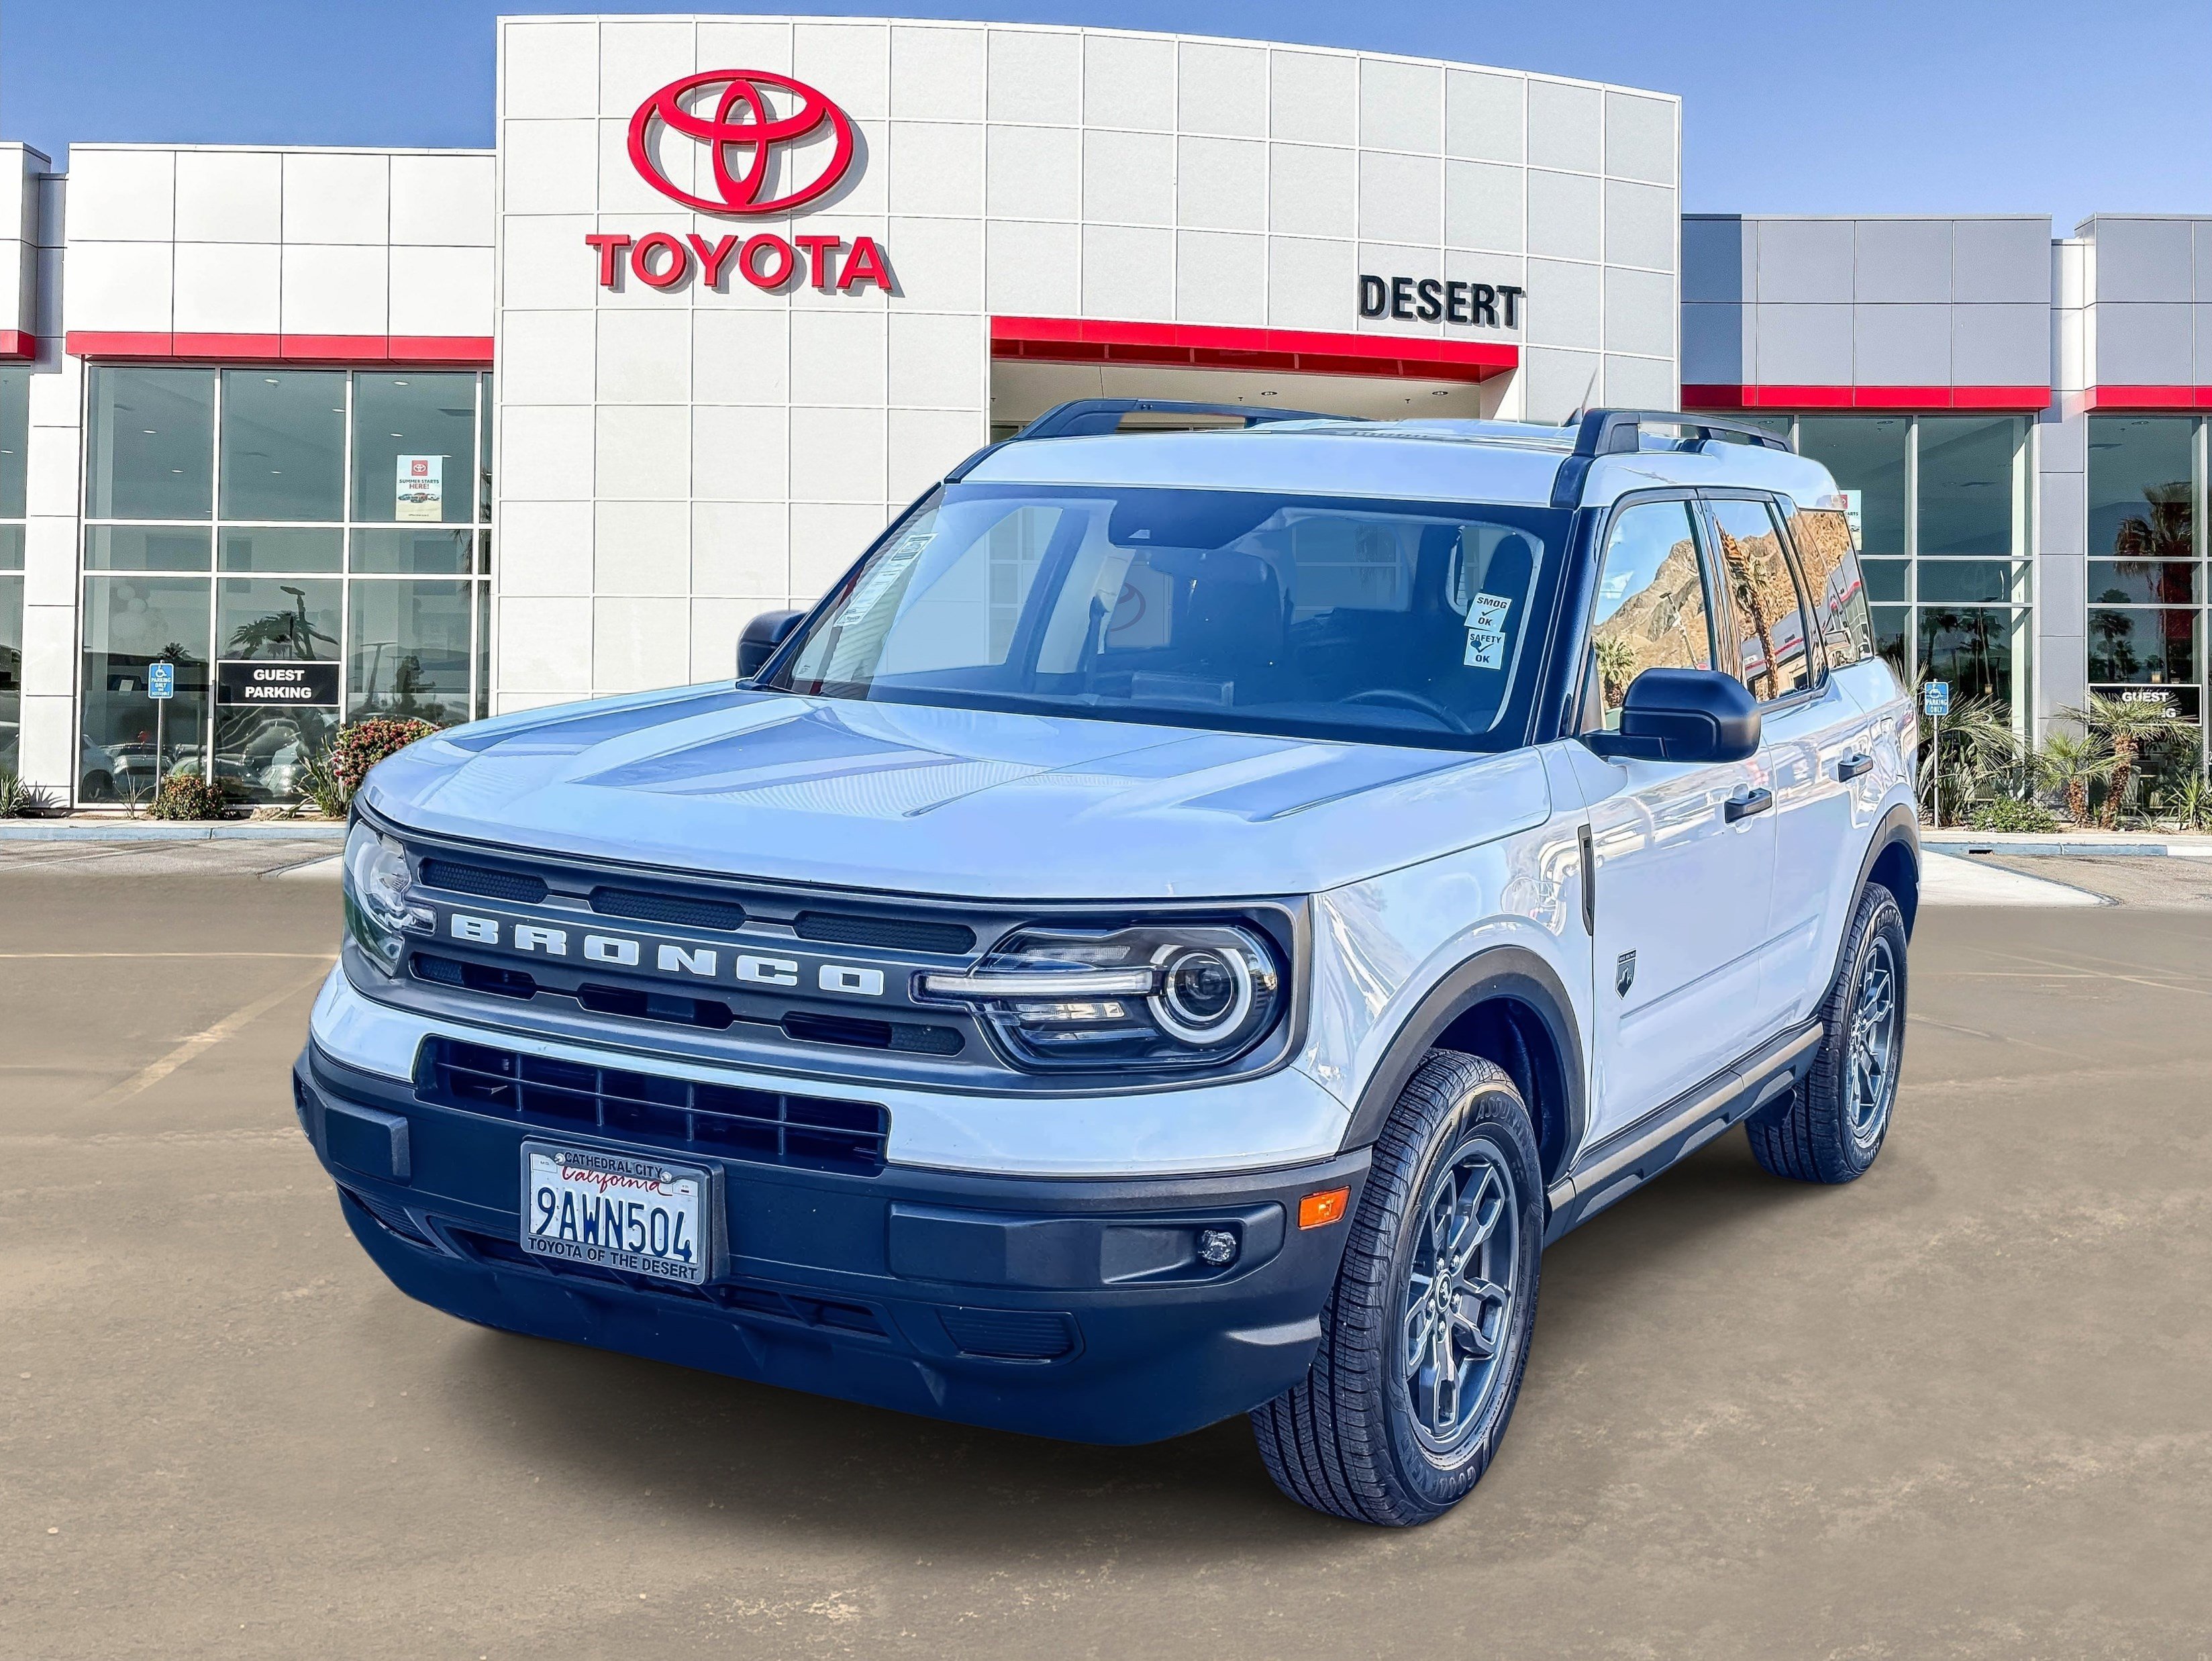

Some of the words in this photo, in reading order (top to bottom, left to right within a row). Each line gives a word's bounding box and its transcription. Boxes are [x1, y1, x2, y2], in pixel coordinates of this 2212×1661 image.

[585, 232, 893, 291] TOYOTA
[1359, 274, 1523, 327] DESERT
[1476, 597, 1507, 609] SMOG
[1478, 617, 1493, 626] OK
[1470, 633, 1502, 644] SAFETY
[1475, 654, 1490, 663] OK
[253, 668, 305, 681] GUEST
[245, 686, 312, 699] PARKING
[2121, 691, 2169, 703] GUEST
[450, 913, 885, 997] BRONCO
[564, 1152, 632, 1174] CATHEDRAL
[635, 1163, 663, 1179] CITY
[561, 1166, 673, 1197] California
[536, 1187, 693, 1263] 9AWN504
[527, 1237, 582, 1259] TOYOTA
[587, 1248, 605, 1262] OF
[610, 1252, 638, 1268] THE
[642, 1258, 698, 1280] DESERT
